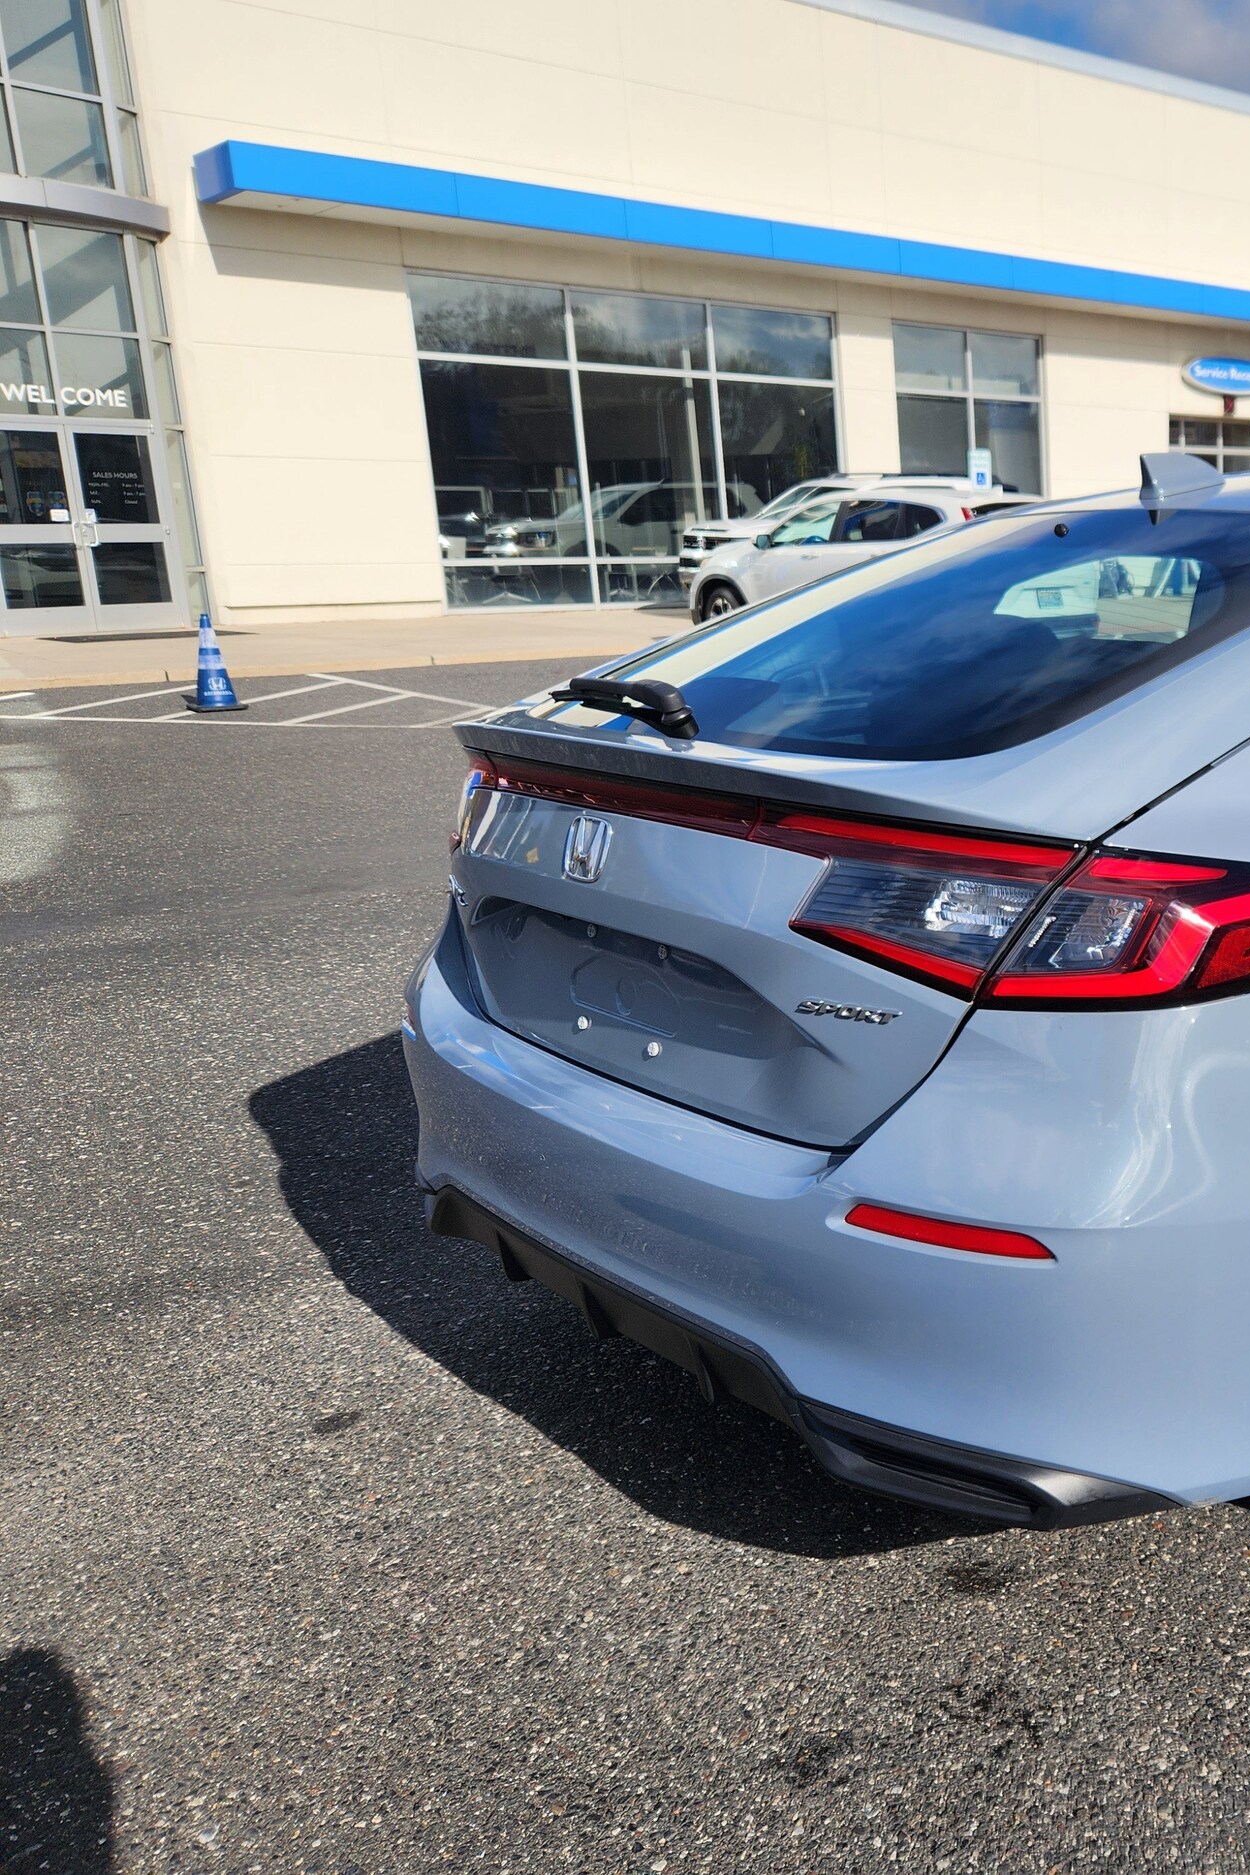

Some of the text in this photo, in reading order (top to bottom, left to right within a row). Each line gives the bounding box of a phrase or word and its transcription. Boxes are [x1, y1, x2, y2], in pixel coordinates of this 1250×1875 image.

[1193, 364, 1228, 380] Service
[0, 382, 129, 409] WELCOME
[795, 999, 903, 1026] SPORT
